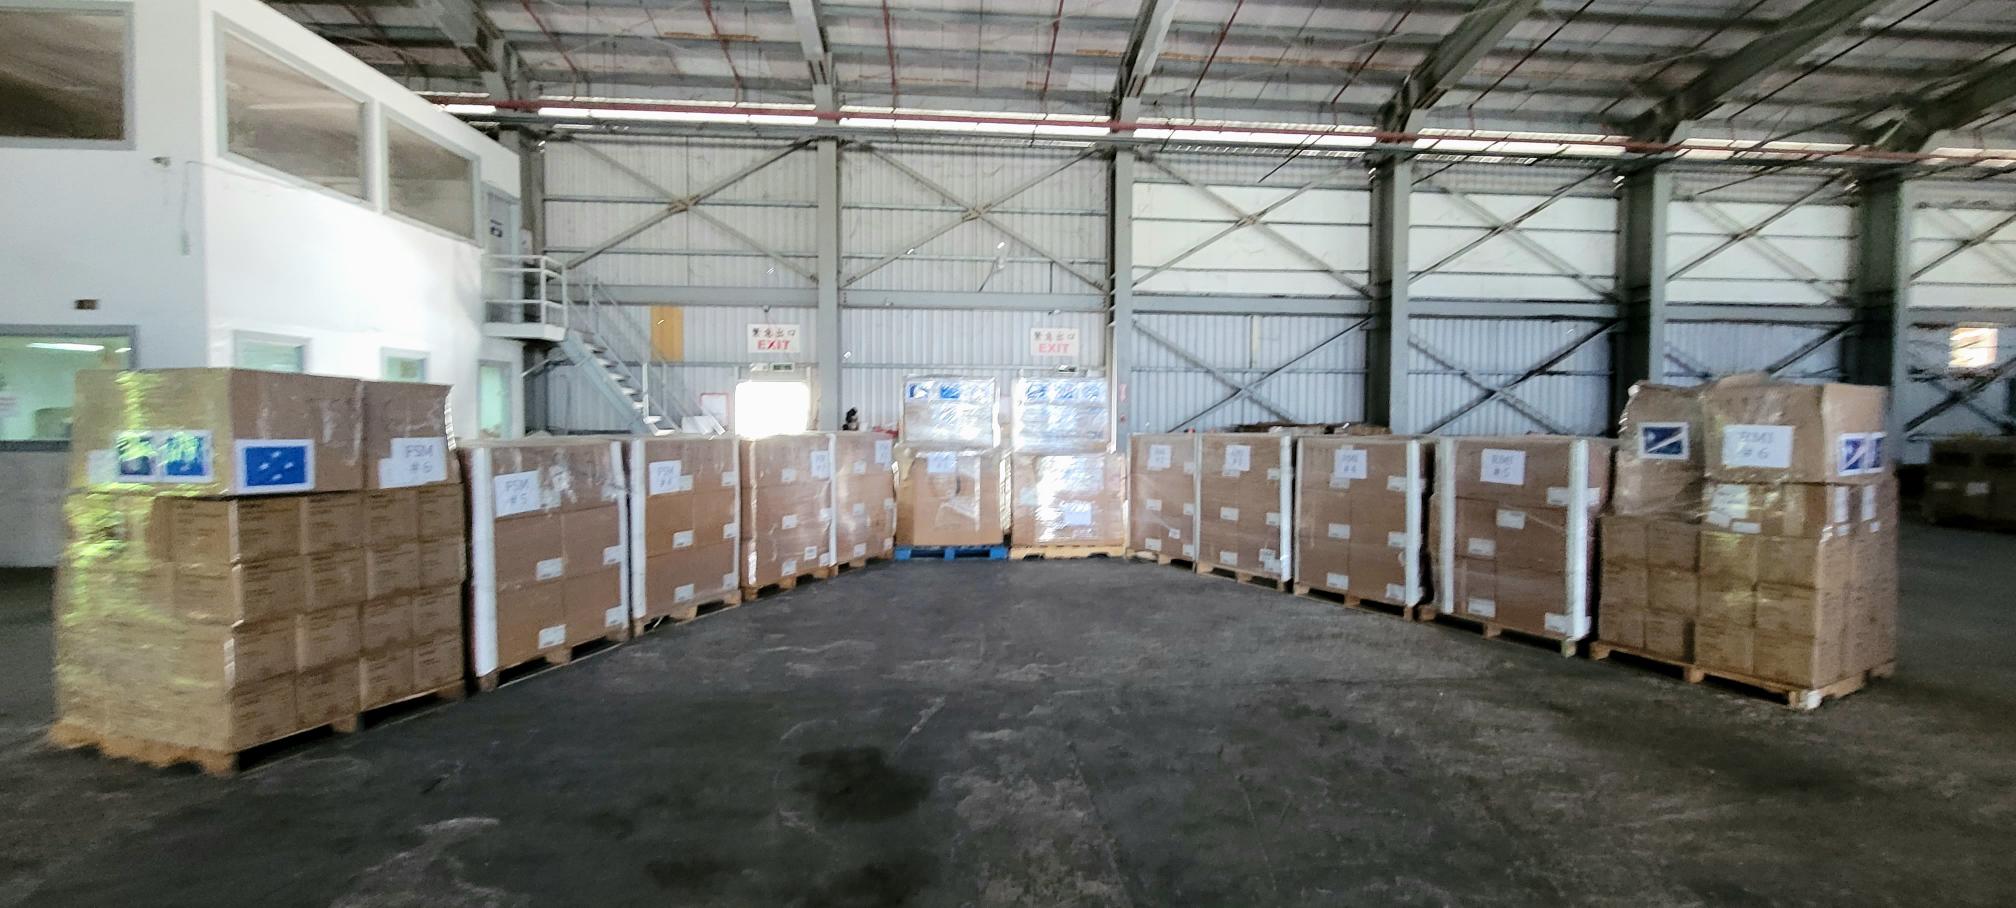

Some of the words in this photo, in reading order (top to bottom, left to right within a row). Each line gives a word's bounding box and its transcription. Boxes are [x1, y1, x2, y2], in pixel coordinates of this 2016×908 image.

[757, 339, 790, 350] EXIT
[1039, 343, 1069, 353] EXIT
[405, 445, 433, 458] FSM
